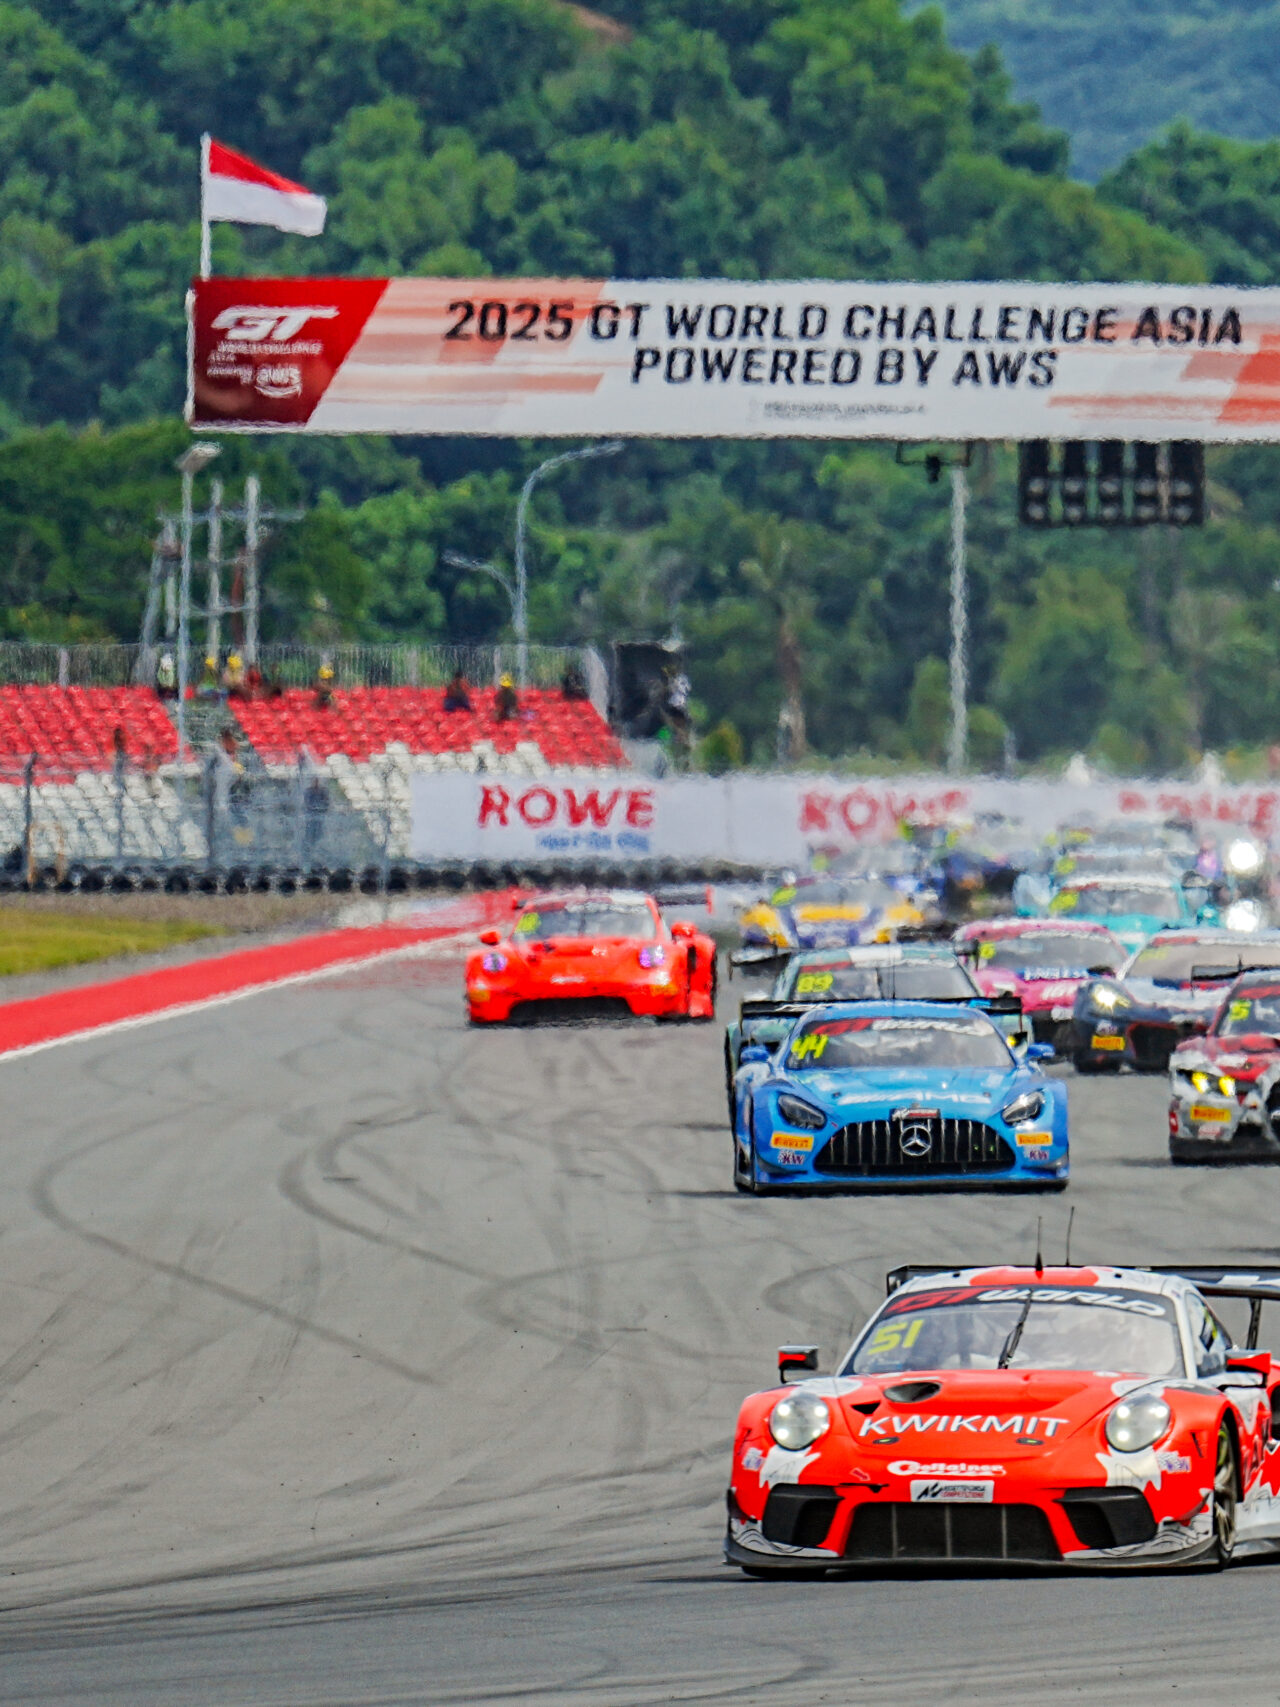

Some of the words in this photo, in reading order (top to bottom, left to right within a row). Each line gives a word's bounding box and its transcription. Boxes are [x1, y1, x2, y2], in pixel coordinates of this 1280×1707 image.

[210, 304, 341, 341] GT
[441, 300, 575, 342] 2025
[588, 302, 651, 341] GT
[666, 303, 828, 342] WORLD
[843, 303, 1119, 345] CHALLENGE
[1131, 304, 1243, 347] ASIA
[630, 346, 862, 386] POWERED
[874, 347, 939, 387] BY
[952, 348, 1060, 388] AWS
[477, 782, 657, 829] ROWE
[976, 1288, 1167, 1317] WORLD
[867, 1318, 925, 1356] 51
[858, 1414, 1070, 1438] KWIKMIT
